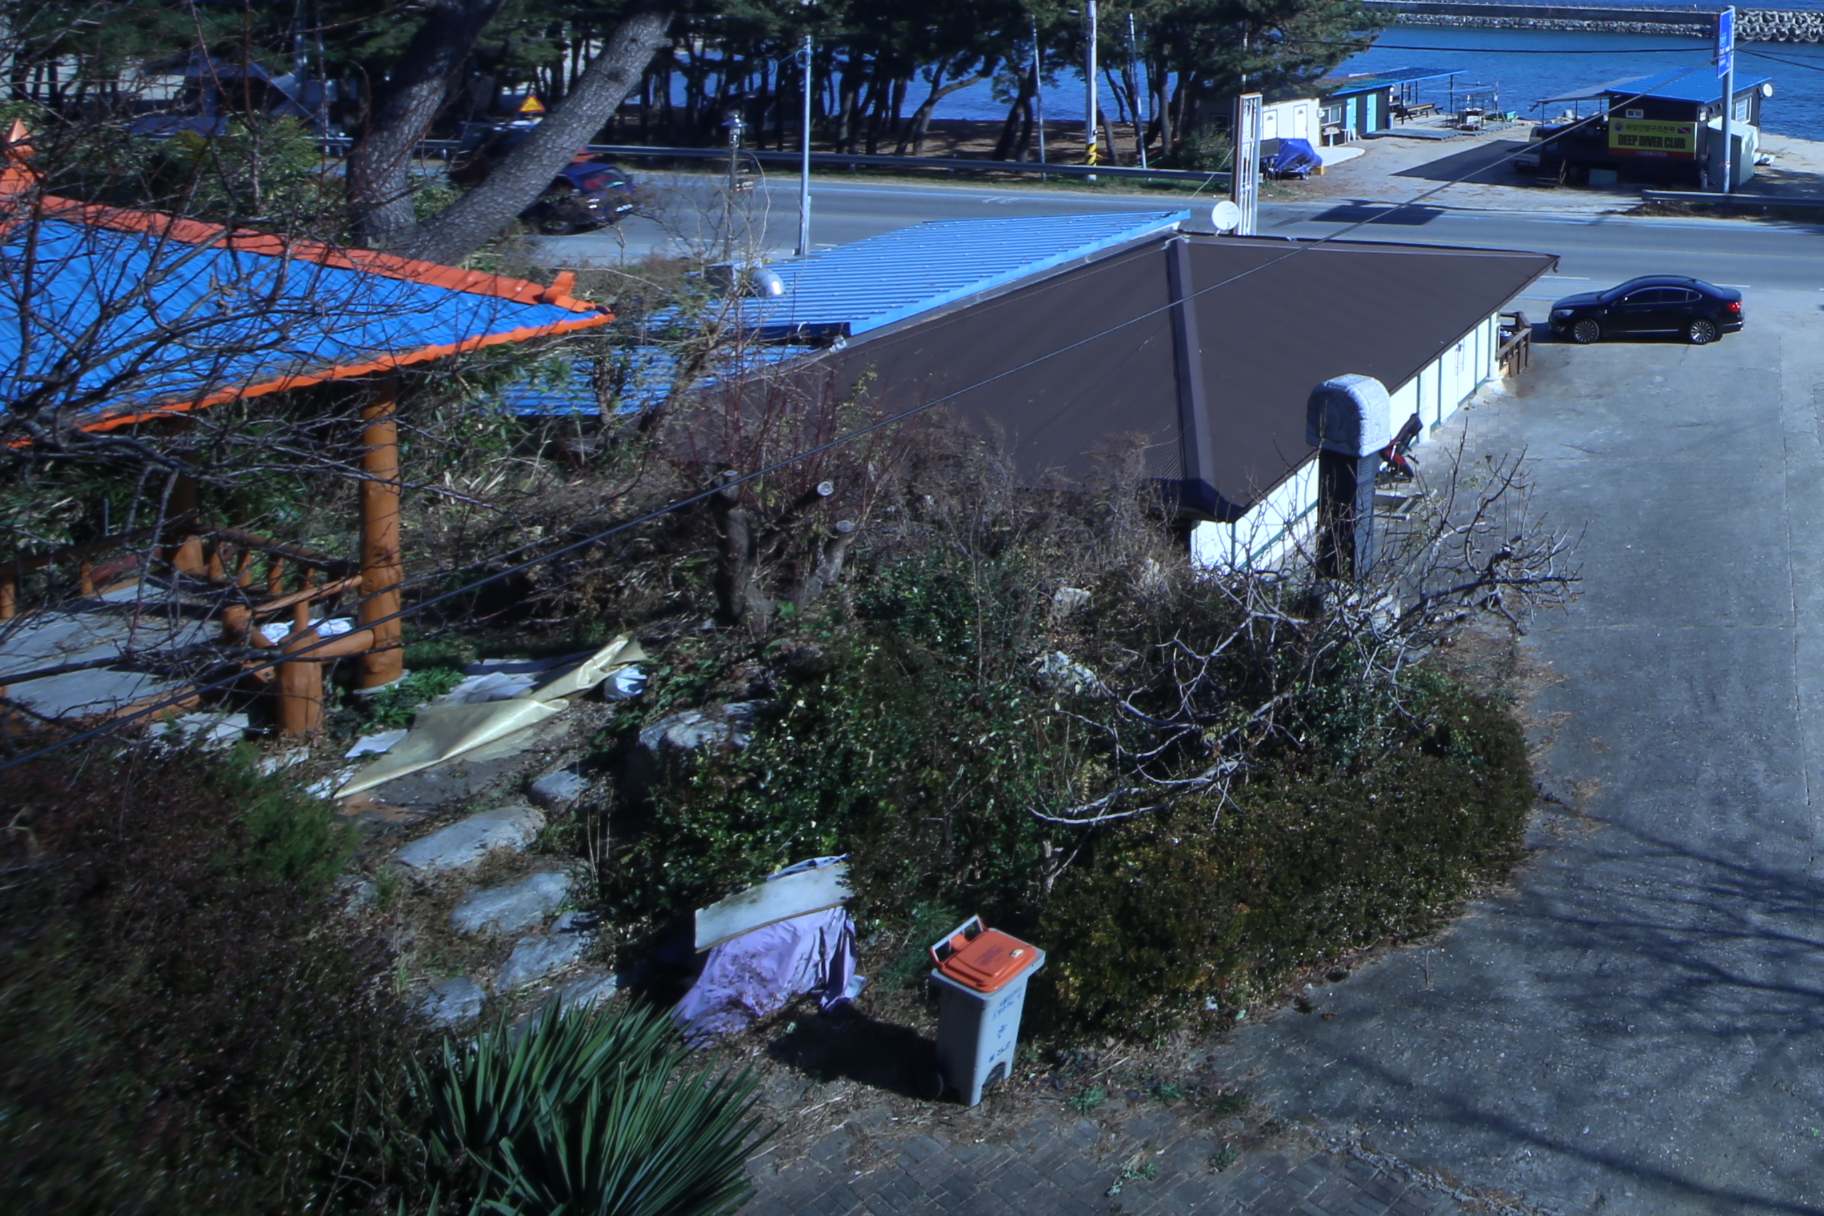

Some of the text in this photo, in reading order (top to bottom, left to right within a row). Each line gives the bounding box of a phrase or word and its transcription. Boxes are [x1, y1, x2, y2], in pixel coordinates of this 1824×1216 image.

[1618, 134, 1686, 149] DEEP DIVER CLUB
